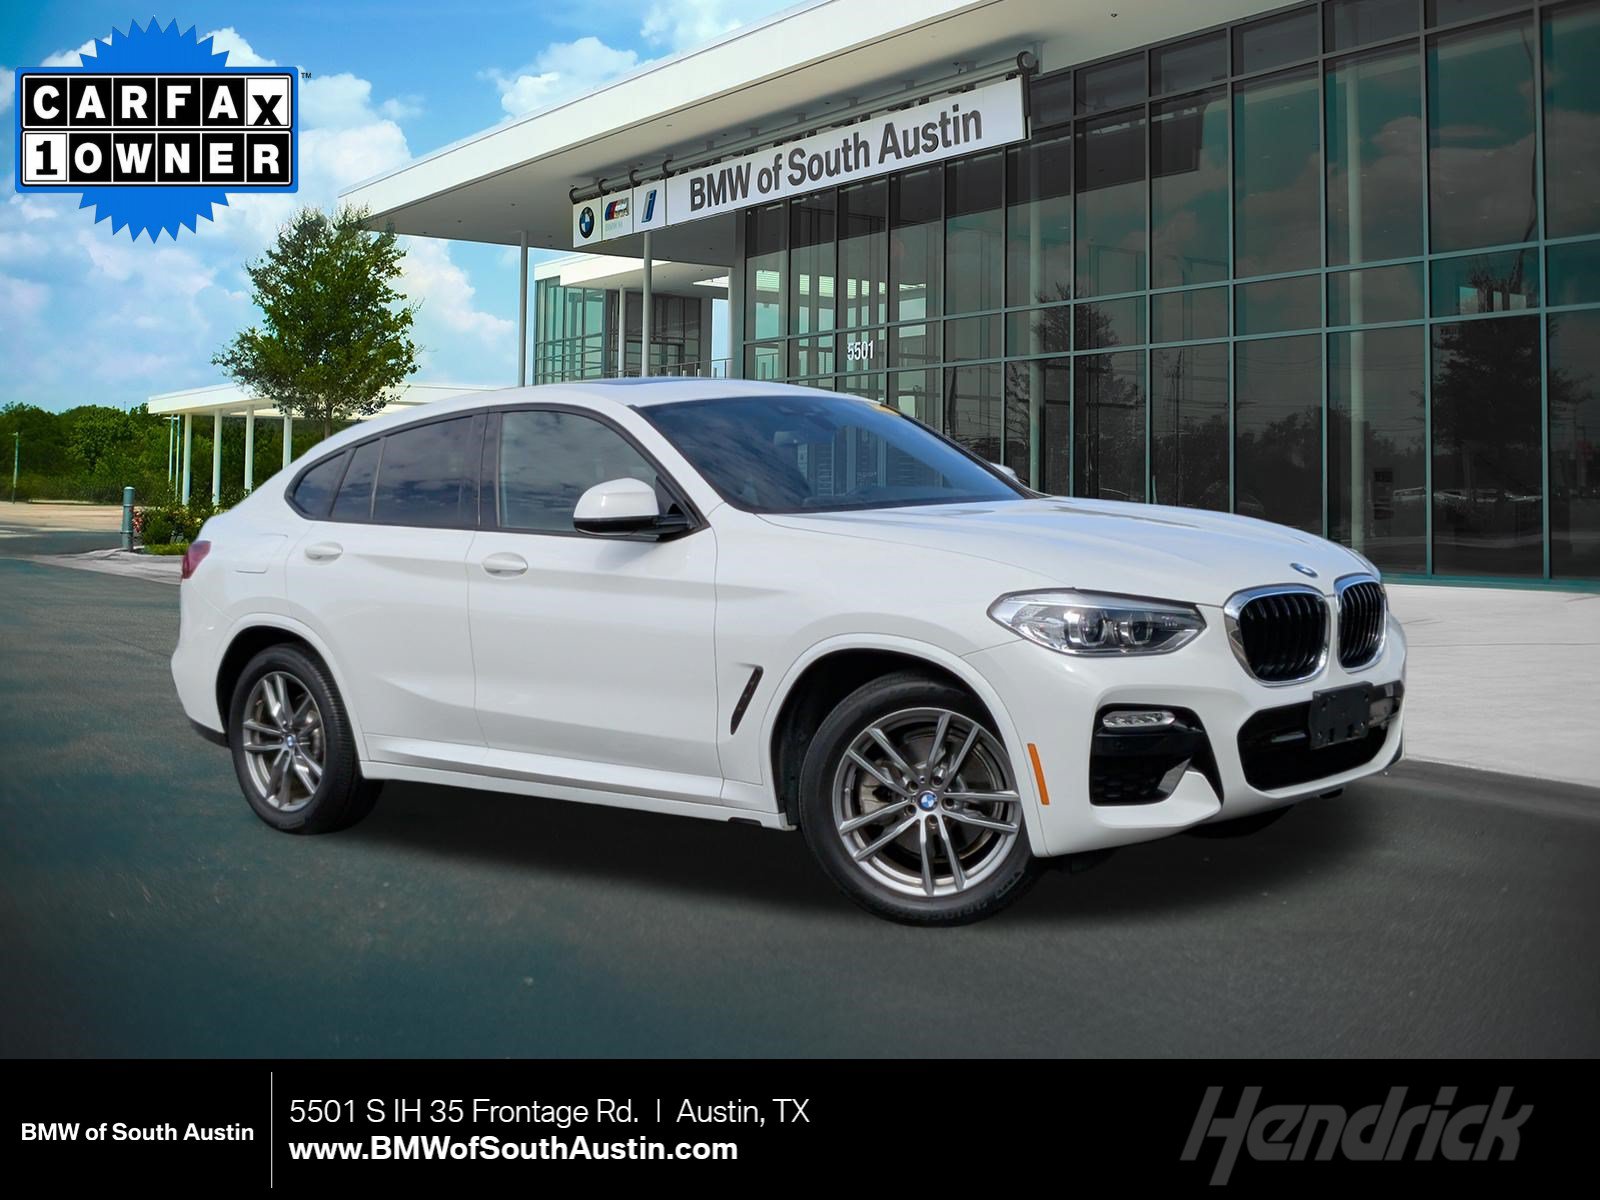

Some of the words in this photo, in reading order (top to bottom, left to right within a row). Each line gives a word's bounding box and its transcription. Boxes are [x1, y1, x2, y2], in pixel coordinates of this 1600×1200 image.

[690, 163, 751, 211] BMW
[757, 153, 783, 194] of
[787, 132, 870, 186] South
[878, 104, 982, 164] Austin
[847, 340, 873, 360] 5501
